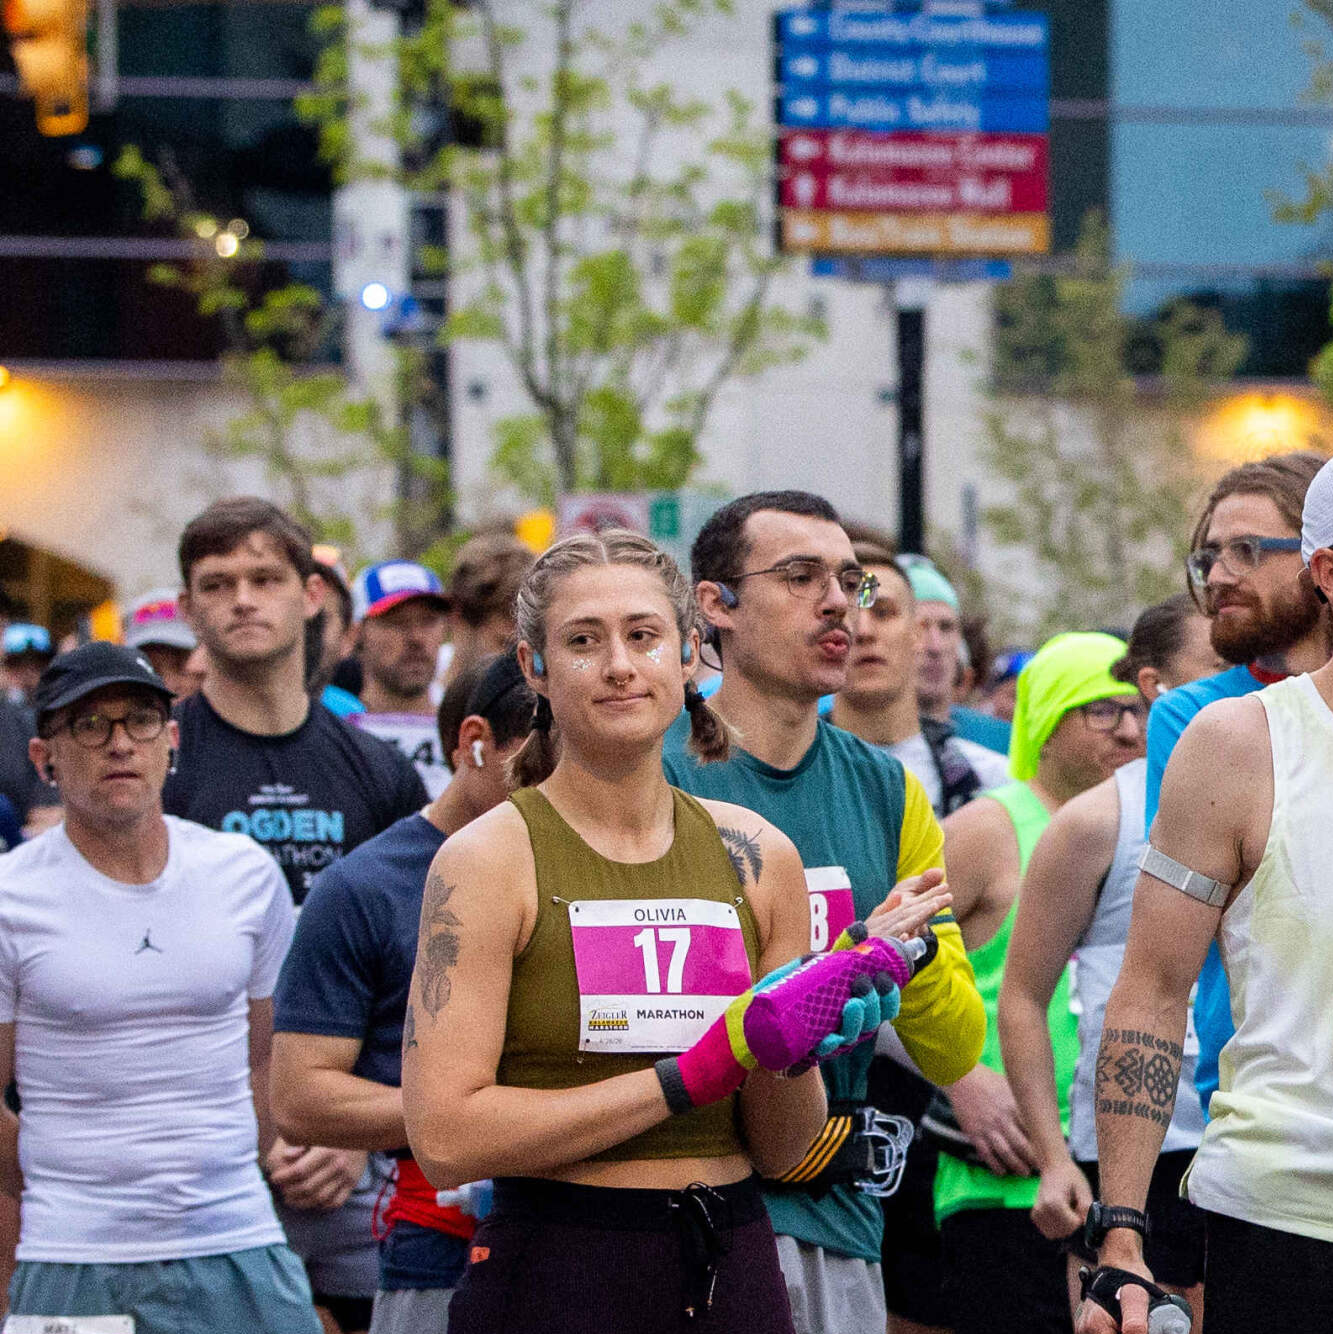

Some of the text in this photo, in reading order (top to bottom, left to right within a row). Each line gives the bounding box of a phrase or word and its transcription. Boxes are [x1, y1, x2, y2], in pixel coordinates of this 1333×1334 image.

[221, 808, 344, 844] OGDEN
[634, 908, 687, 922] OLIVIA
[633, 927, 691, 993] 17
[636, 1009, 705, 1020] MARATHON
